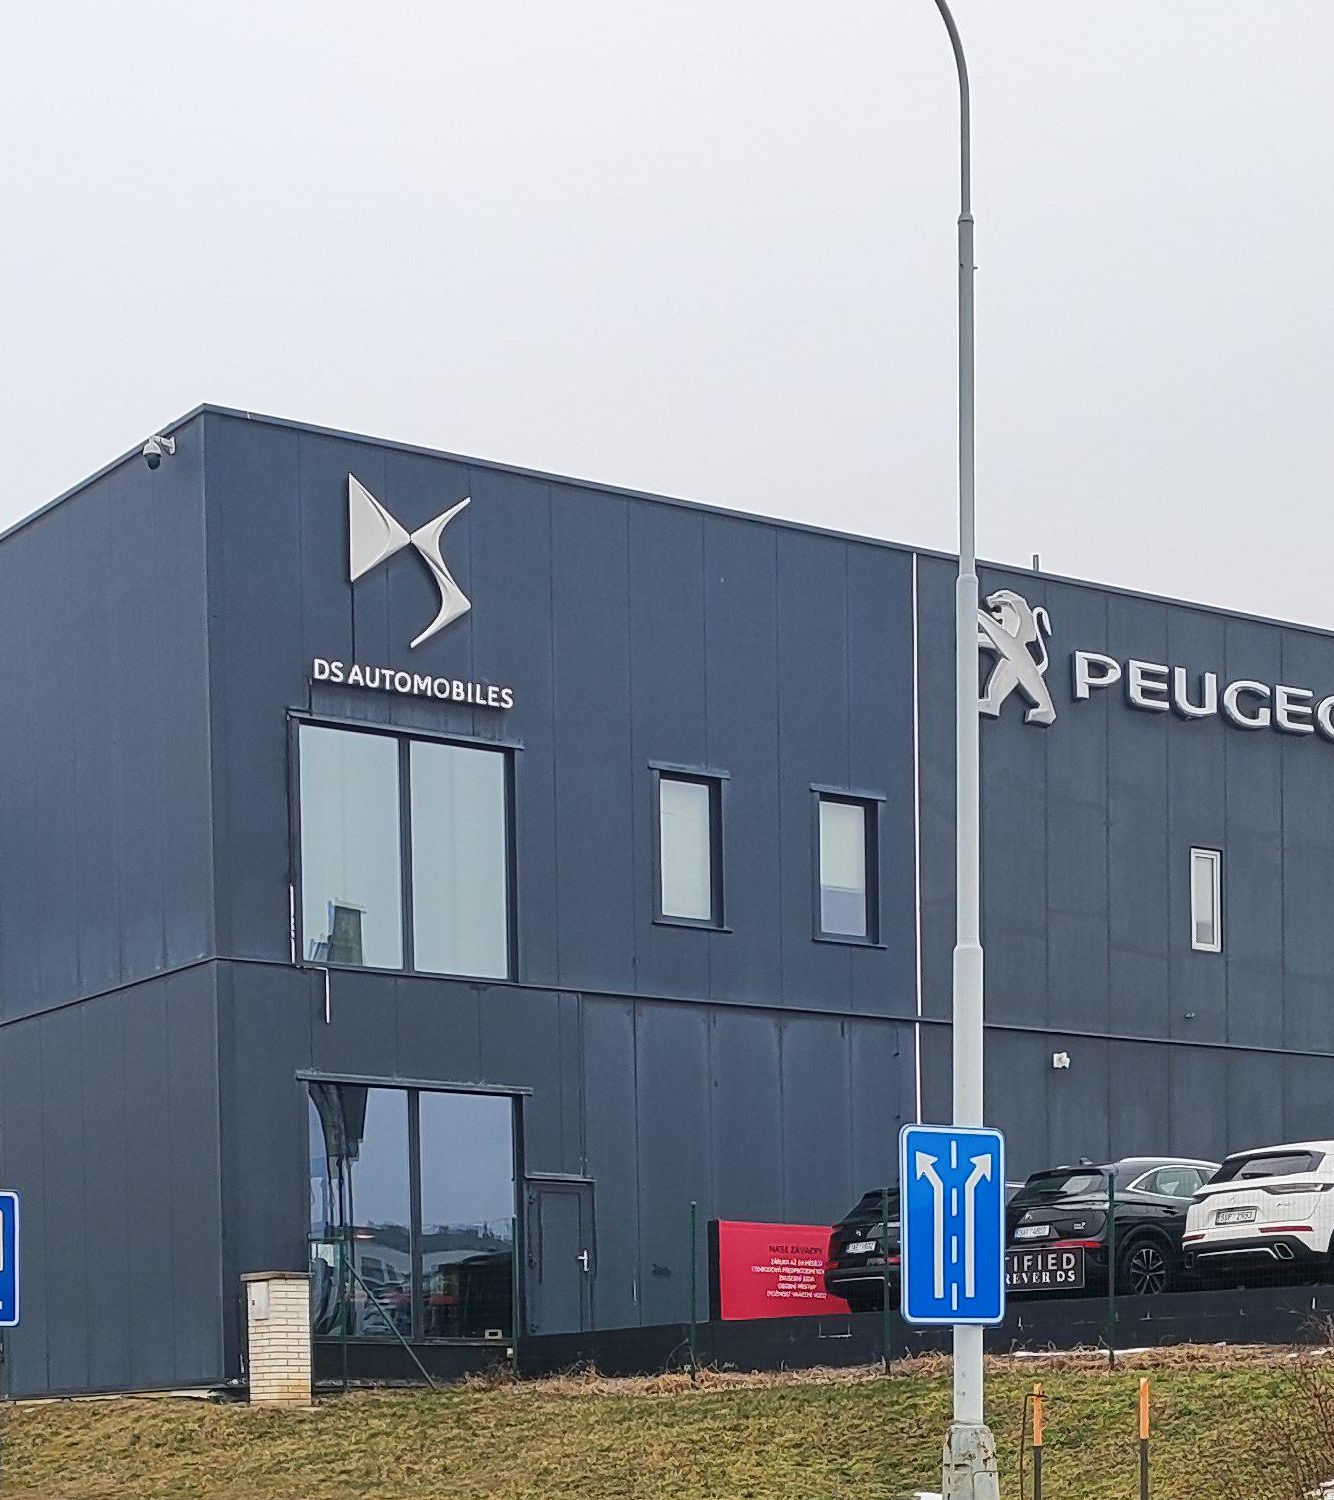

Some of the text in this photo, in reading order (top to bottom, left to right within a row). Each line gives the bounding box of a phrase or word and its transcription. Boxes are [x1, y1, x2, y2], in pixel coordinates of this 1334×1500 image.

[313, 657, 515, 710] DS AUTOMOBILES
[1056, 1270, 1076, 1283] DS
